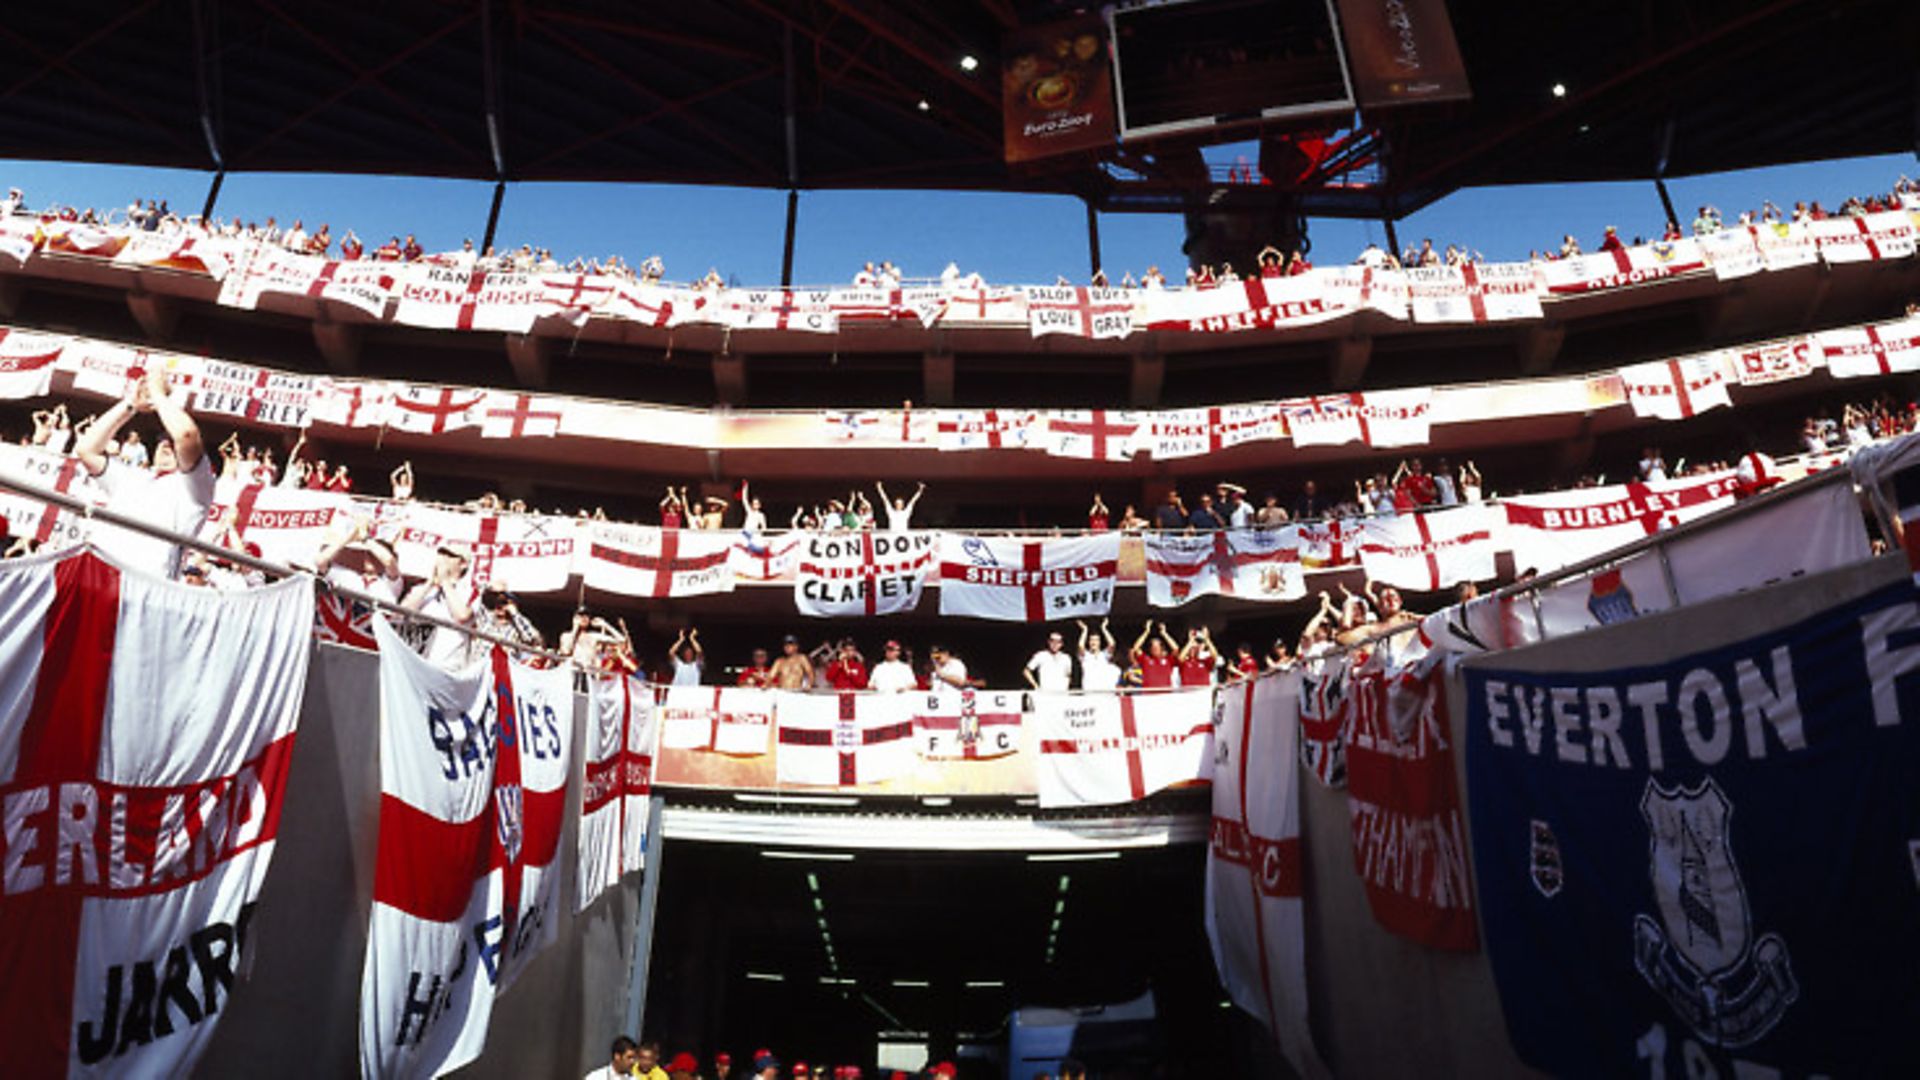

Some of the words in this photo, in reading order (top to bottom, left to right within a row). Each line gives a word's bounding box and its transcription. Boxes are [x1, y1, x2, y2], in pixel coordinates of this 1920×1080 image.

[428, 269, 528, 285] RANERS
[807, 313, 822, 329] C
[1040, 309, 1076, 327] LOVE
[1095, 315, 1132, 334] GRAY
[249, 510, 330, 528] ROVERS
[1543, 492, 1681, 528] BURNLEY
[514, 540, 572, 556] TOWN
[809, 536, 931, 558] LONDON
[965, 567, 1099, 587] SHEFFIELD
[802, 574, 916, 603] CLARET
[927, 696, 940, 710] B
[994, 695, 1007, 707] C
[1484, 645, 1808, 771] EVERTON
[928, 738, 939, 752] F
[997, 733, 1010, 750] C
